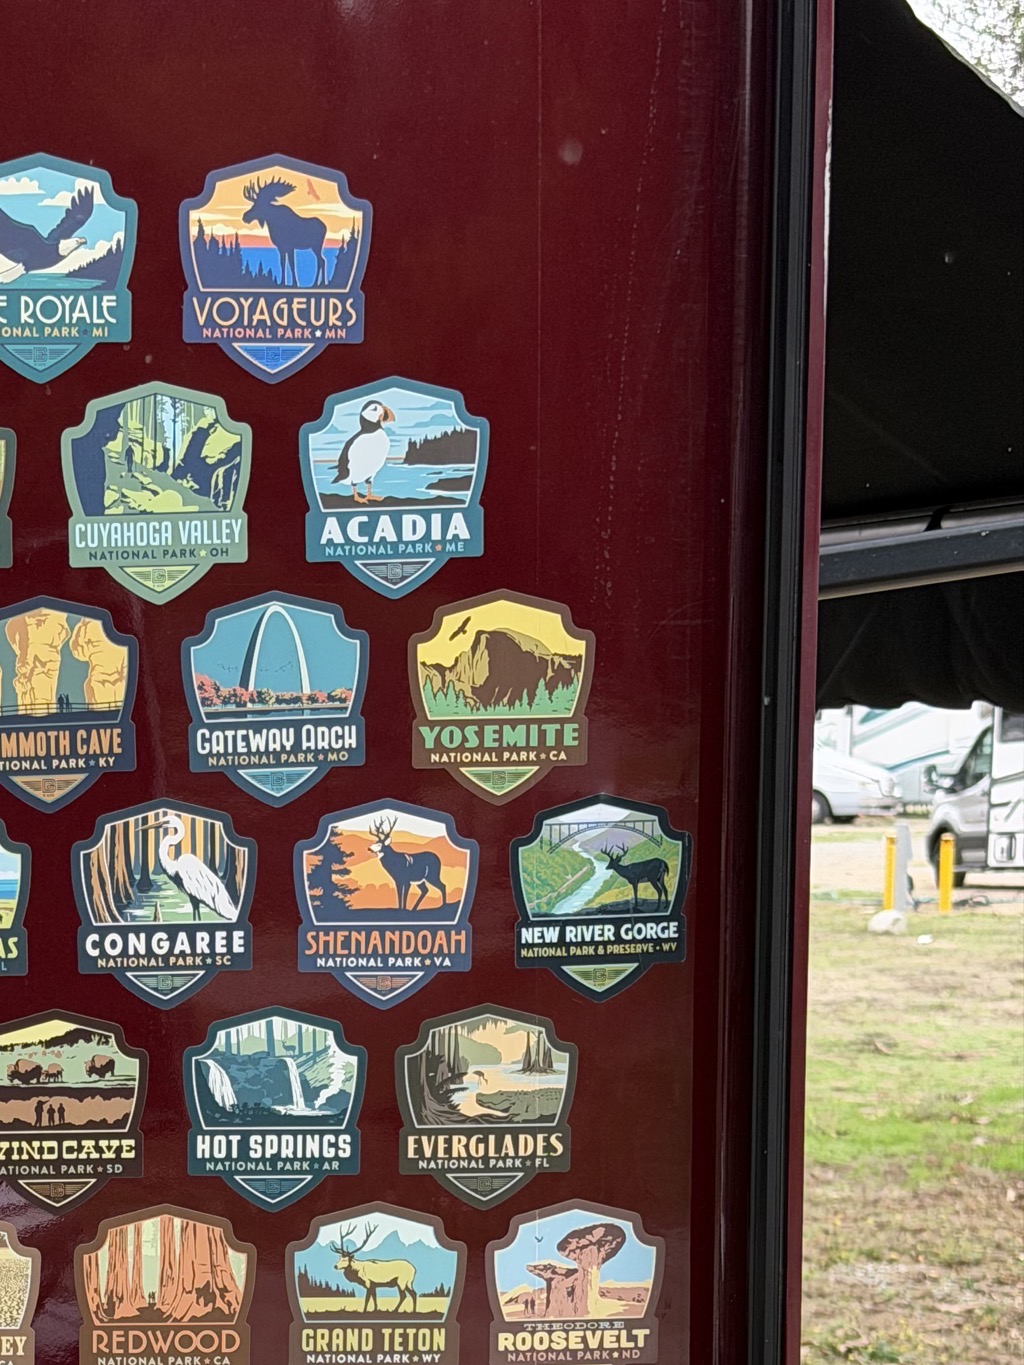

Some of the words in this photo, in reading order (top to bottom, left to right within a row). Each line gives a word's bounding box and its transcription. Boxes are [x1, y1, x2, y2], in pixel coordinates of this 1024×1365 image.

[20, 295, 117, 324] ROYALE
[192, 296, 357, 327] VOYAGEURS
[75, 521, 172, 548] CUYAHOGA
[178, 518, 242, 545] VALLEY
[320, 512, 471, 545] ACADIA
[325, 544, 394, 557] NATIONAL
[398, 542, 433, 554] PARK
[445, 541, 465, 552] ME
[76, 728, 122, 755] CAVE
[196, 727, 295, 755] GATEWAY
[301, 724, 357, 751] ARCH
[418, 723, 579, 749] YOSEMITE
[208, 754, 276, 767] NATIONAL
[280, 752, 315, 764] PARK
[327, 751, 349, 762] MO
[85, 930, 245, 957] CONGAREE
[304, 929, 466, 955] SHENANDOAH
[521, 926, 561, 944] NEW
[565, 924, 616, 943] RIVER
[619, 921, 679, 941] GORGE
[520, 946, 568, 958] NATIONAL
[569, 945, 596, 956] PARK
[597, 944, 605, 955] &
[606, 942, 654, 955] PRESERVE
[661, 941, 677, 952] WV
[62, 1139, 136, 1160] CAVE
[196, 1134, 242, 1159] HOT
[249, 1134, 352, 1159] SPRINGS
[407, 1132, 564, 1159] EVERGLADES
[206, 1161, 273, 1171] NATIONAL
[277, 1160, 310, 1171] PARK
[322, 1160, 340, 1171] AR
[523, 1321, 625, 1331] THEODORE
[92, 1329, 241, 1354] REDWOOD
[301, 1328, 373, 1352] GRAND
[381, 1327, 446, 1352] TETON
[497, 1328, 650, 1352] ROOSEVELT
[507, 1351, 573, 1363] NATIONAL
[577, 1350, 610, 1360] PARK
[622, 1349, 641, 1359] ND
